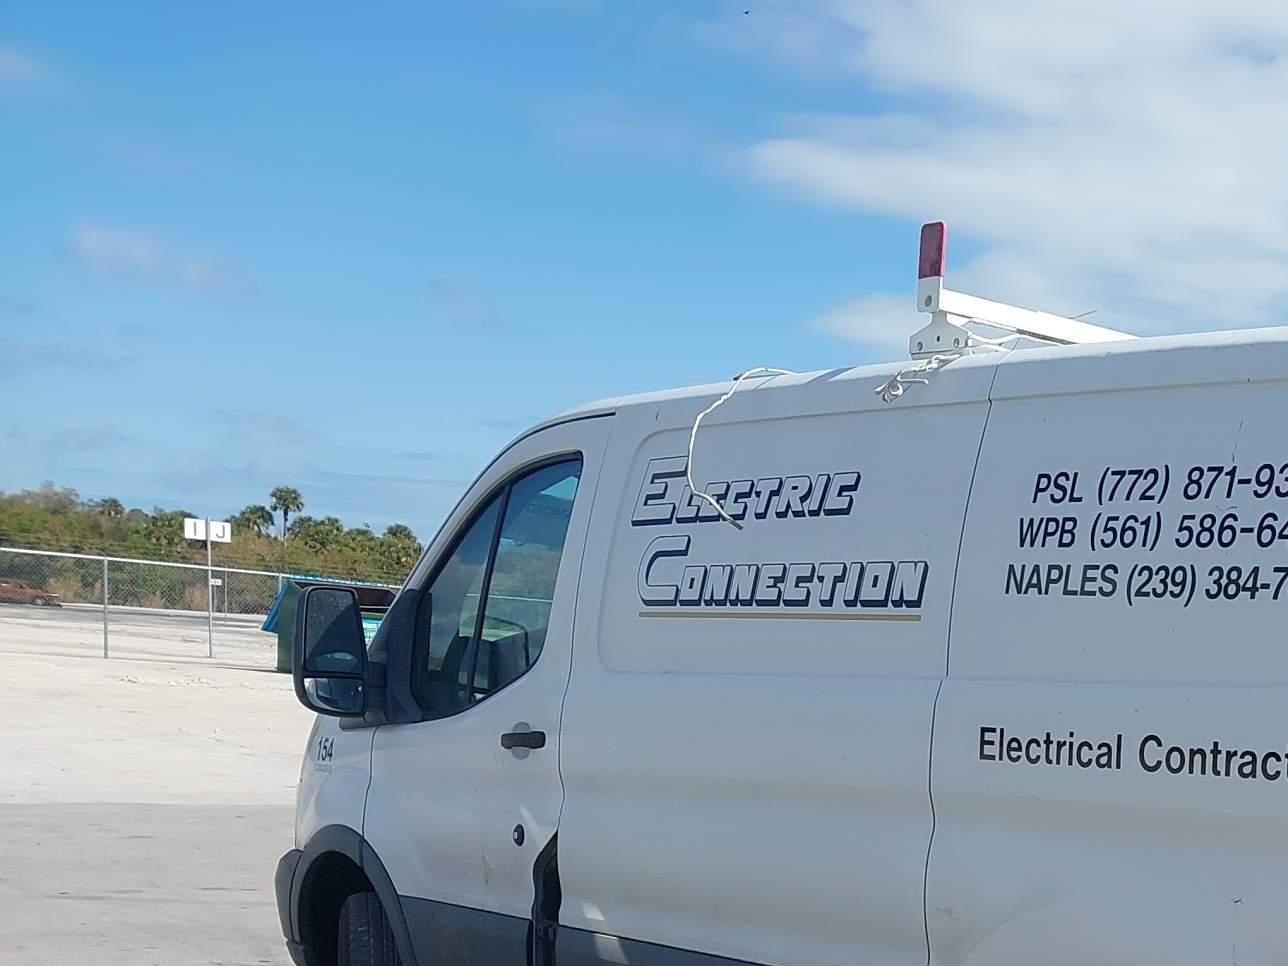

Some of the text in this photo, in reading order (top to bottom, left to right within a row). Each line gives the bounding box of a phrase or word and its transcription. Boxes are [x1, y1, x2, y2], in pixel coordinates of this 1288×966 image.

[631, 456, 861, 526] ELECTRIC
[1032, 472, 1084, 503] PSL
[1098, 465, 1170, 505] (772)
[215, 525, 225, 539] J
[1018, 516, 1078, 548] WPB
[1090, 511, 1162, 551] (561)
[638, 534, 929, 608] CONNECTION
[1004, 564, 1119, 597] NAPLES
[1126, 564, 1197, 607] (239)
[317, 736, 335, 762] 154
[978, 726, 1123, 770] Electrical
